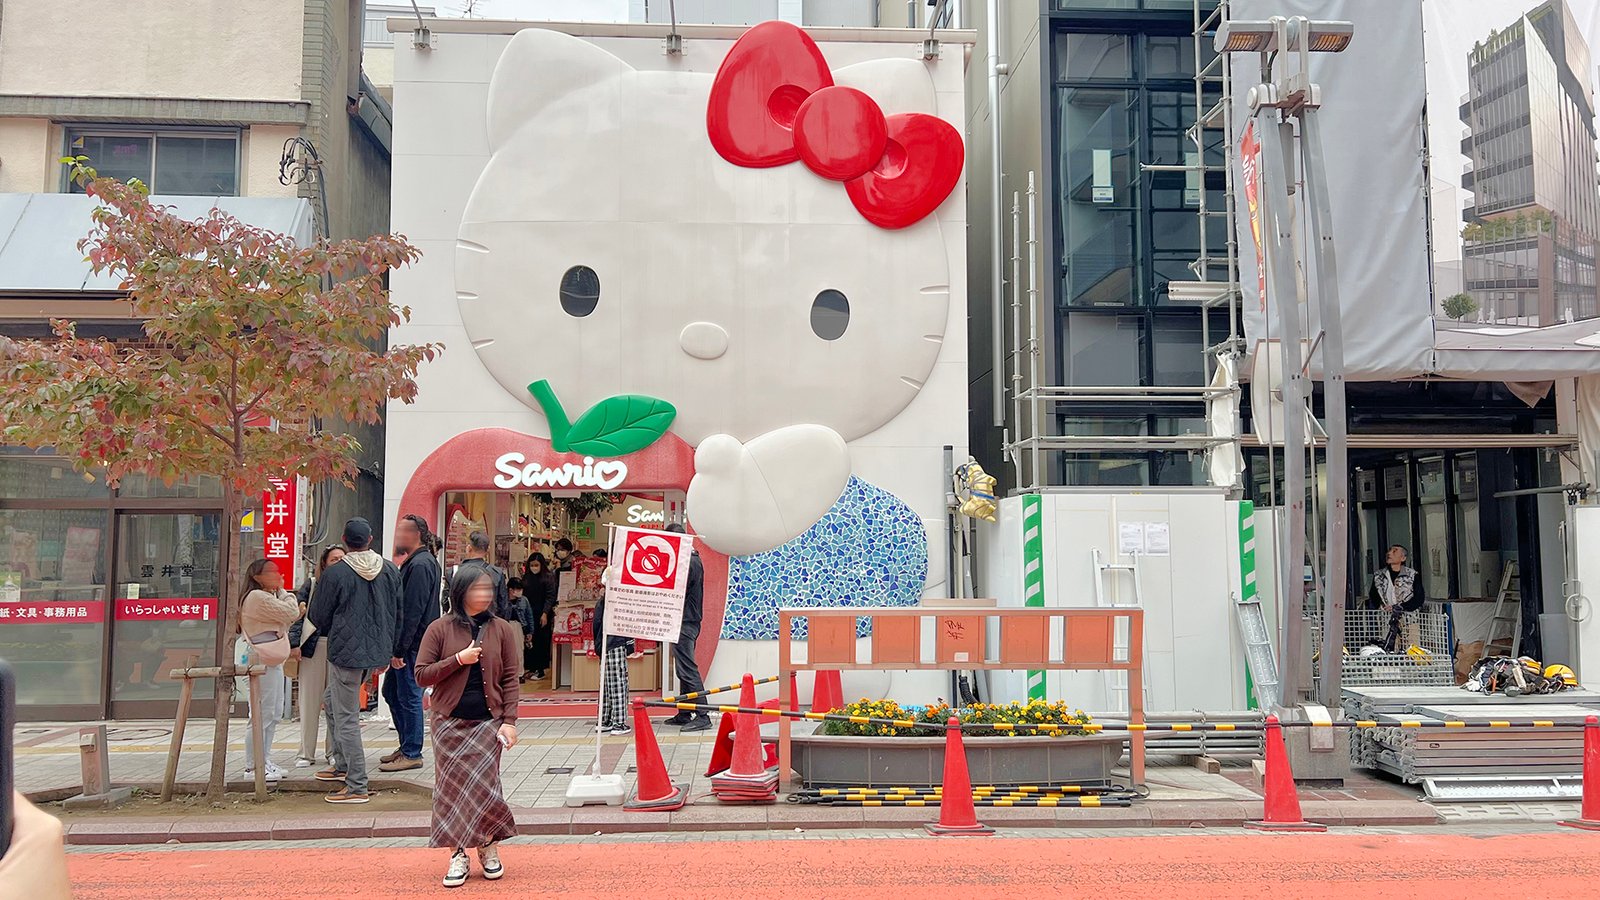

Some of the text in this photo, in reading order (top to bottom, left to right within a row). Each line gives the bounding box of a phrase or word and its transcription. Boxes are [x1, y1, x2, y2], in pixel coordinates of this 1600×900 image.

[494, 452, 628, 490] Sanrio
[141, 564, 195, 578] 雲井堂
[125, 604, 201, 615] いらっしゃいませ
